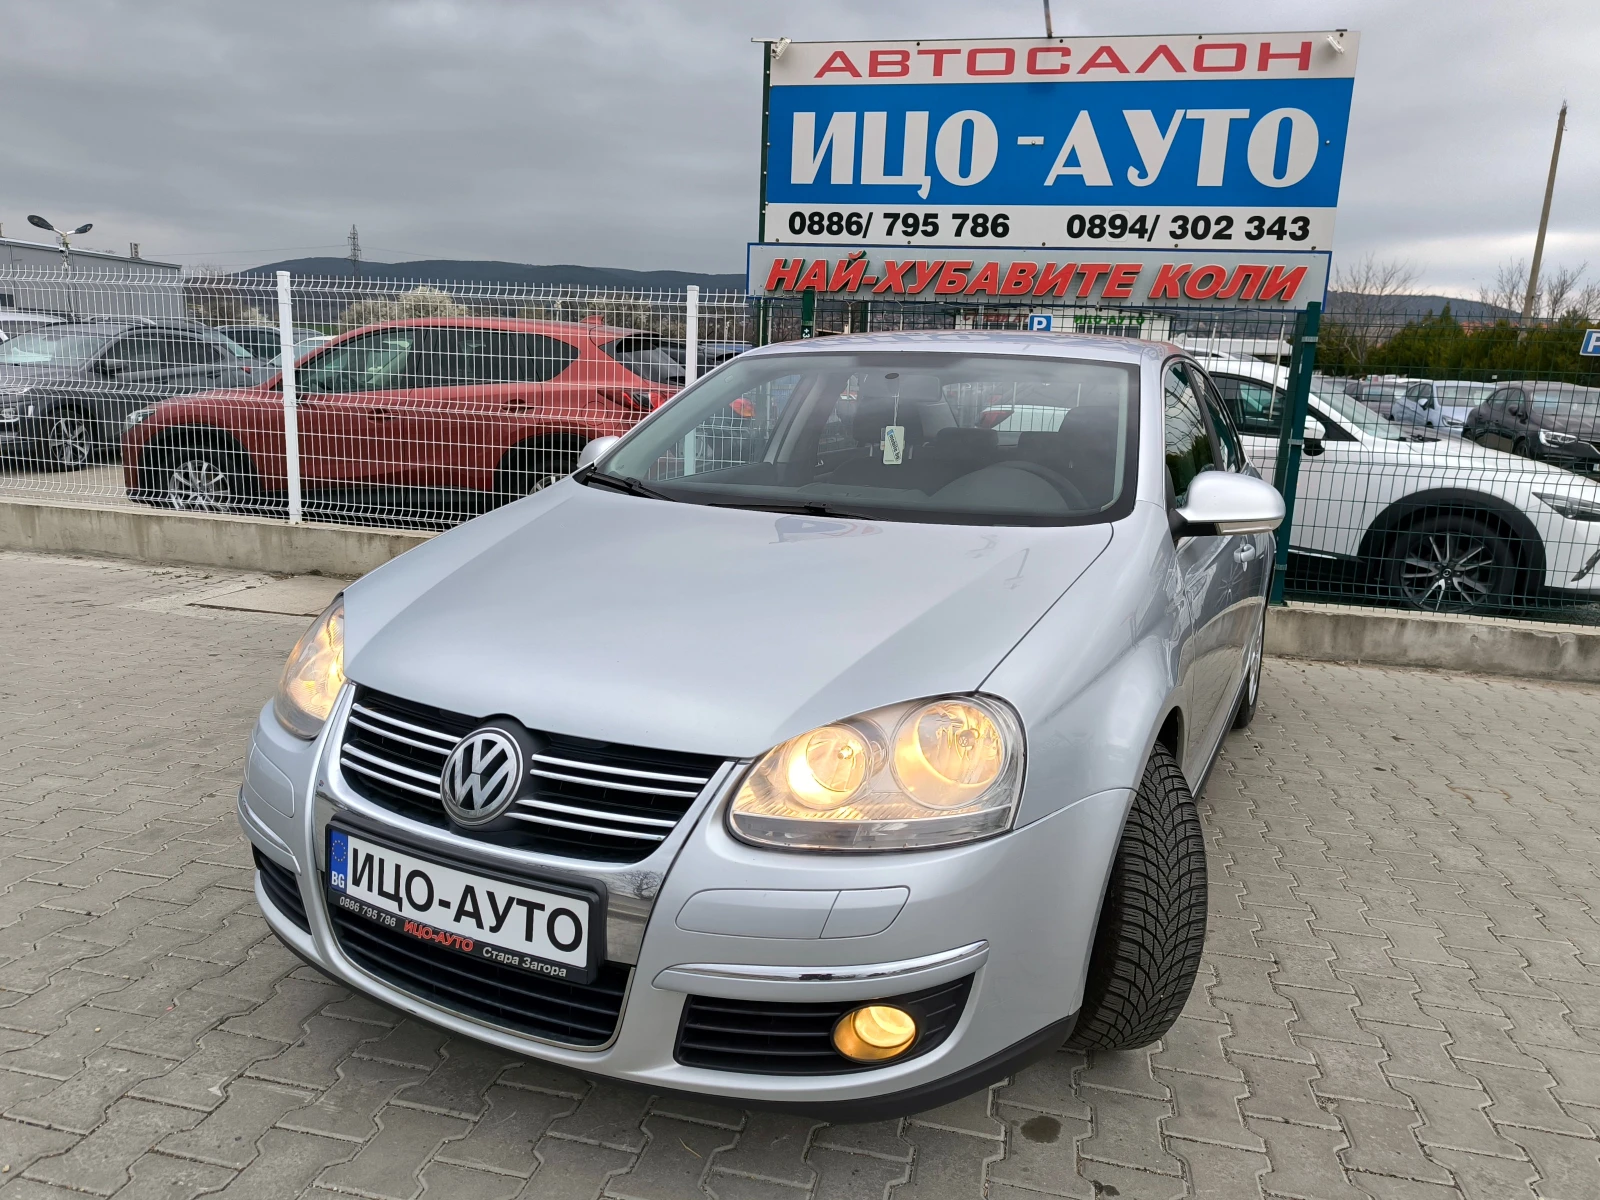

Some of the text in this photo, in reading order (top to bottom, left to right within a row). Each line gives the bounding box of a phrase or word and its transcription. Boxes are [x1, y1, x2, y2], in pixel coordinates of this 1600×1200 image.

[814, 42, 1312, 78] АВТОСАЛОН
[788, 211, 1009, 238] 0886/ 795 786
[1066, 213, 1310, 241] 0894/ 302 343
[764, 250, 1308, 301] НАЙ-ХУБАВИТЕ КОЛИ
[1033, 317, 1047, 331] P
[331, 871, 345, 889] BG
[339, 897, 396, 928] 0886 795 786
[351, 848, 583, 953] ИЦО-АУТО
[403, 919, 474, 952] ИЦО-АУТО
[482, 946, 567, 978] Стара Загора
